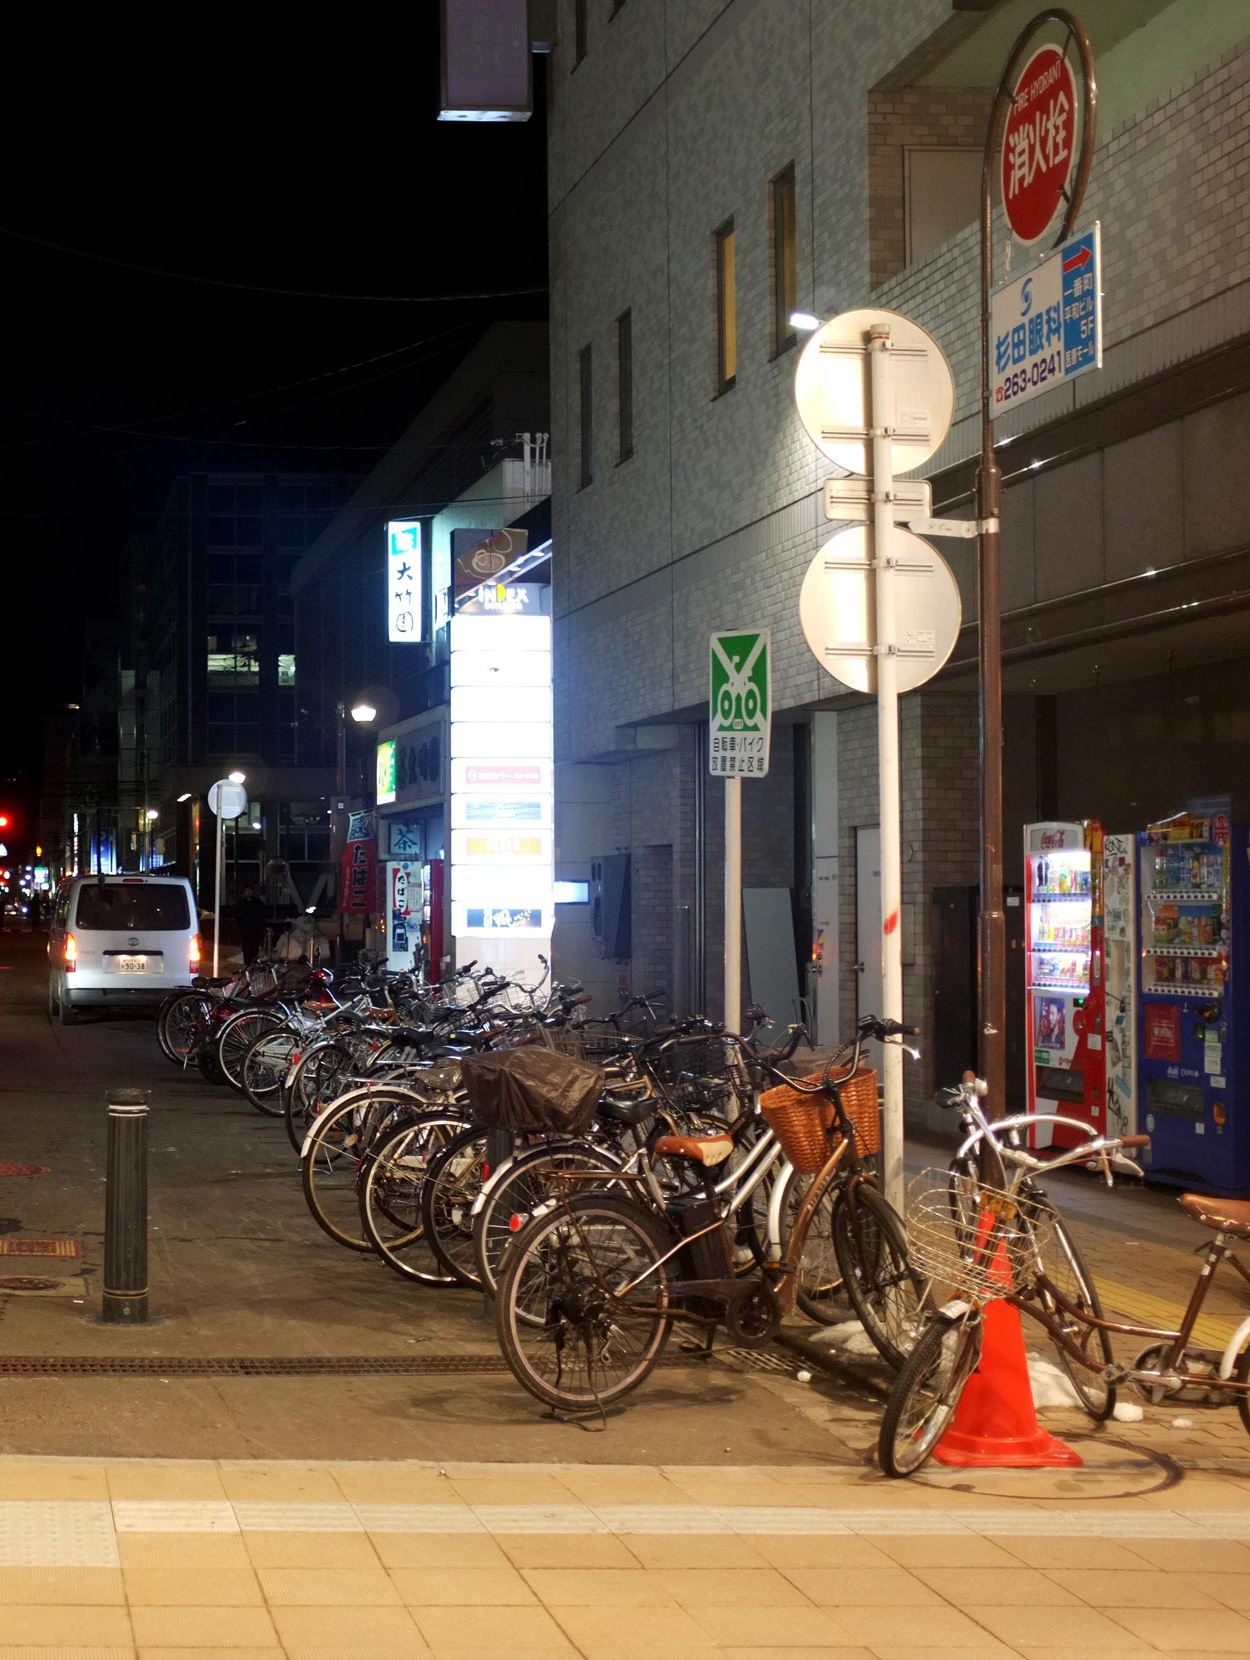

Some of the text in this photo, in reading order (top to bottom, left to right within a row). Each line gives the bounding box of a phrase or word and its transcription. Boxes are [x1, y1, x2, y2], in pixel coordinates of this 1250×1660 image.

[1013, 60, 1062, 116] FIRE HYDRANT
[1008, 90, 1070, 199] 消火栓
[1063, 271, 1093, 298] 一番町
[1063, 297, 1093, 324] 平和ビル
[1080, 314, 1094, 339] 5F
[995, 301, 1062, 375] 杉田眼科
[1003, 350, 1062, 401] 263-0241
[393, 825, 418, 852] 茶
